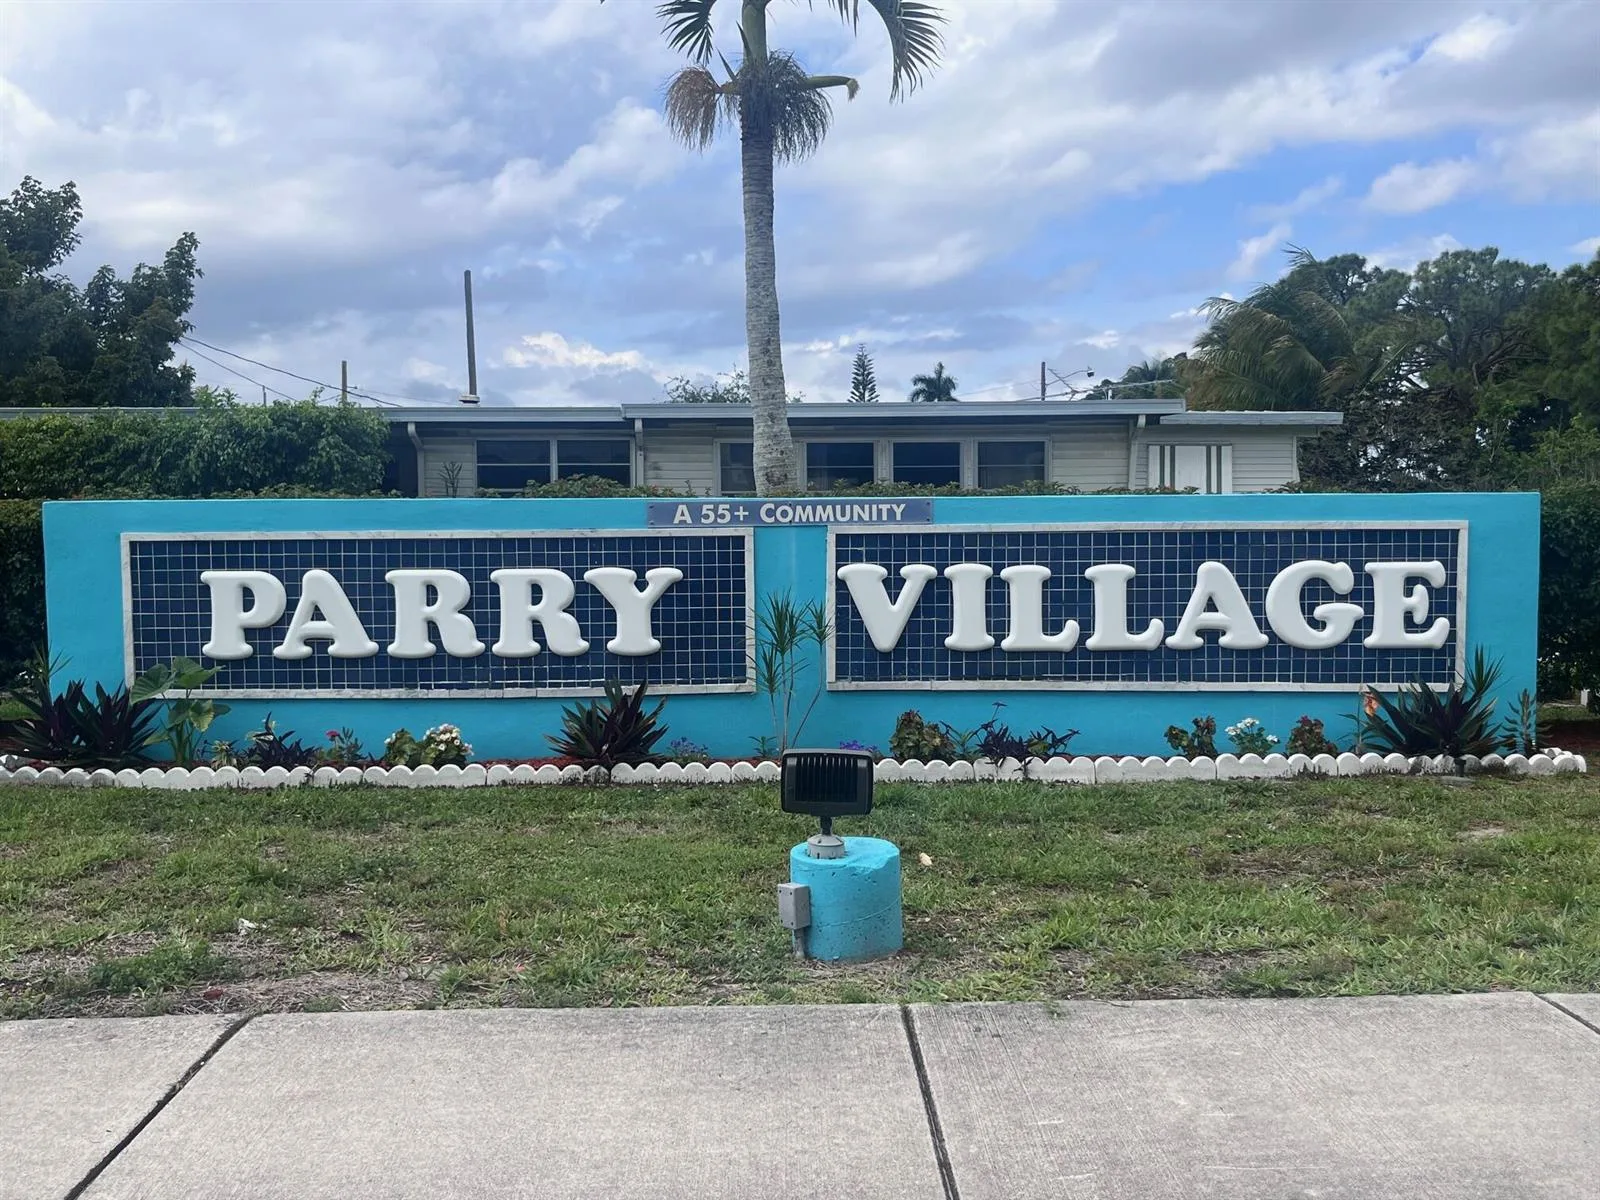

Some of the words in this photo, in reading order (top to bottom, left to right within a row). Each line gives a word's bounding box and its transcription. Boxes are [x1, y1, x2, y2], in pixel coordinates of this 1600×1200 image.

[673, 504, 693, 525] A
[700, 503, 749, 525] 55+
[759, 502, 906, 524] COMMUNITY
[200, 566, 684, 661] PARRY
[836, 558, 1451, 653] VILLAGE
